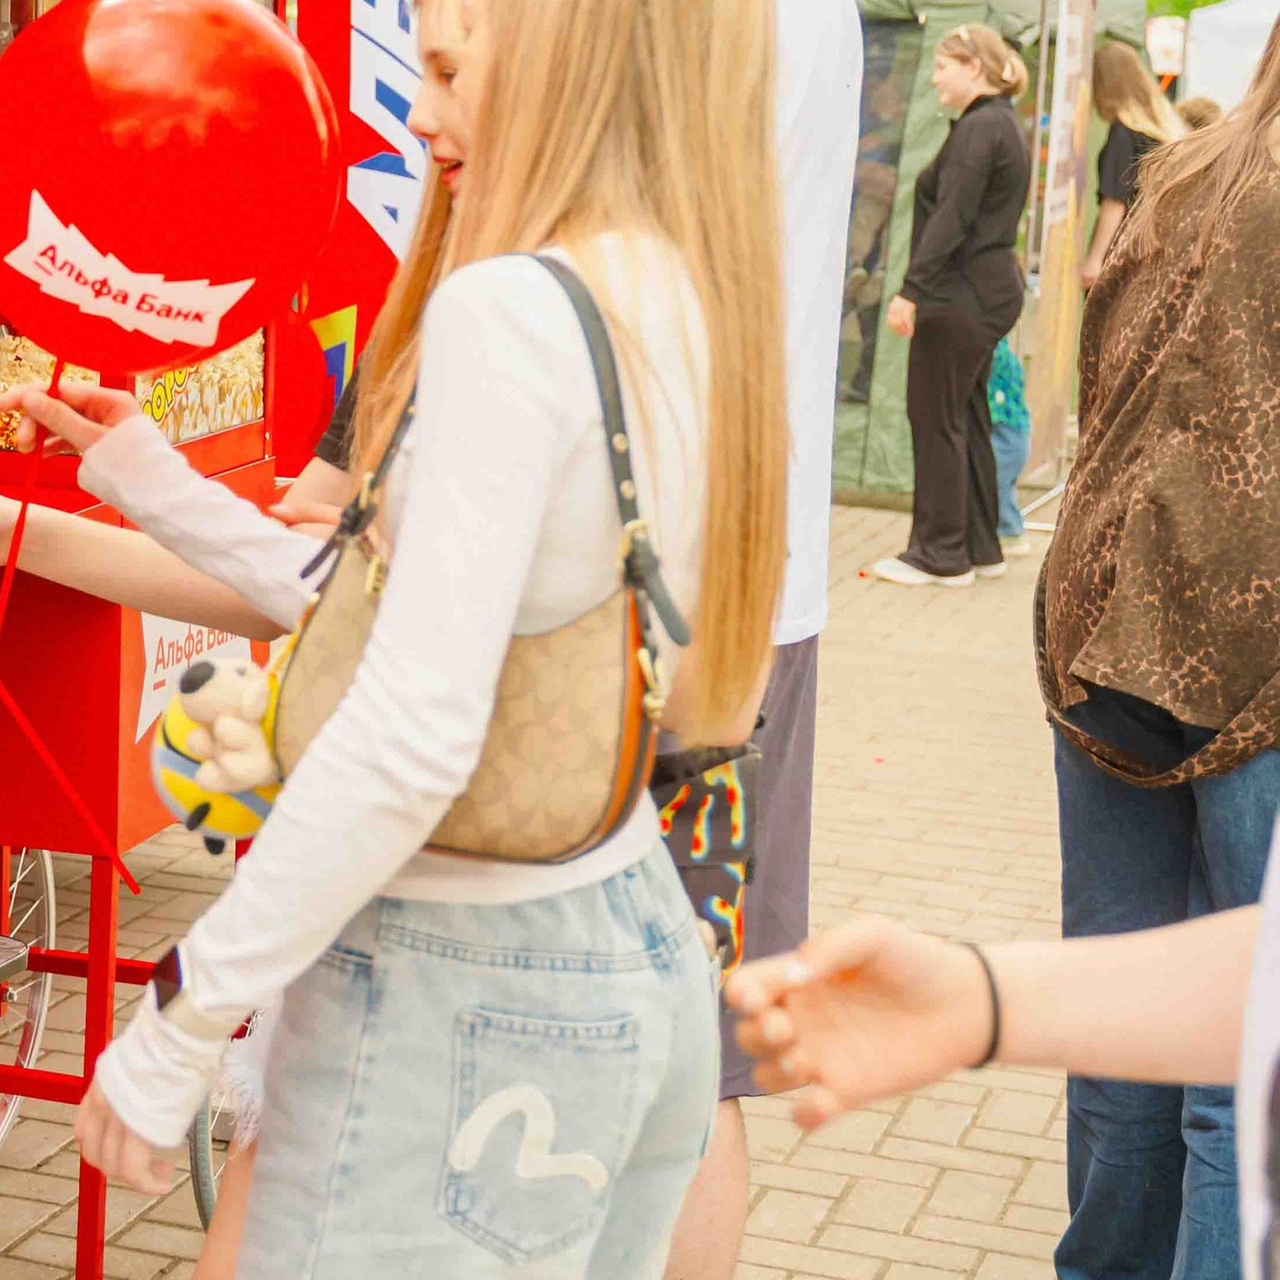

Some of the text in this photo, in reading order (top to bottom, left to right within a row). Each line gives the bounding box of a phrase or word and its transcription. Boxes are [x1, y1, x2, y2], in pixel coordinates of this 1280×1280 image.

[38, 243, 211, 324] Альфа Банк
[153, 624, 204, 674] Альфа
